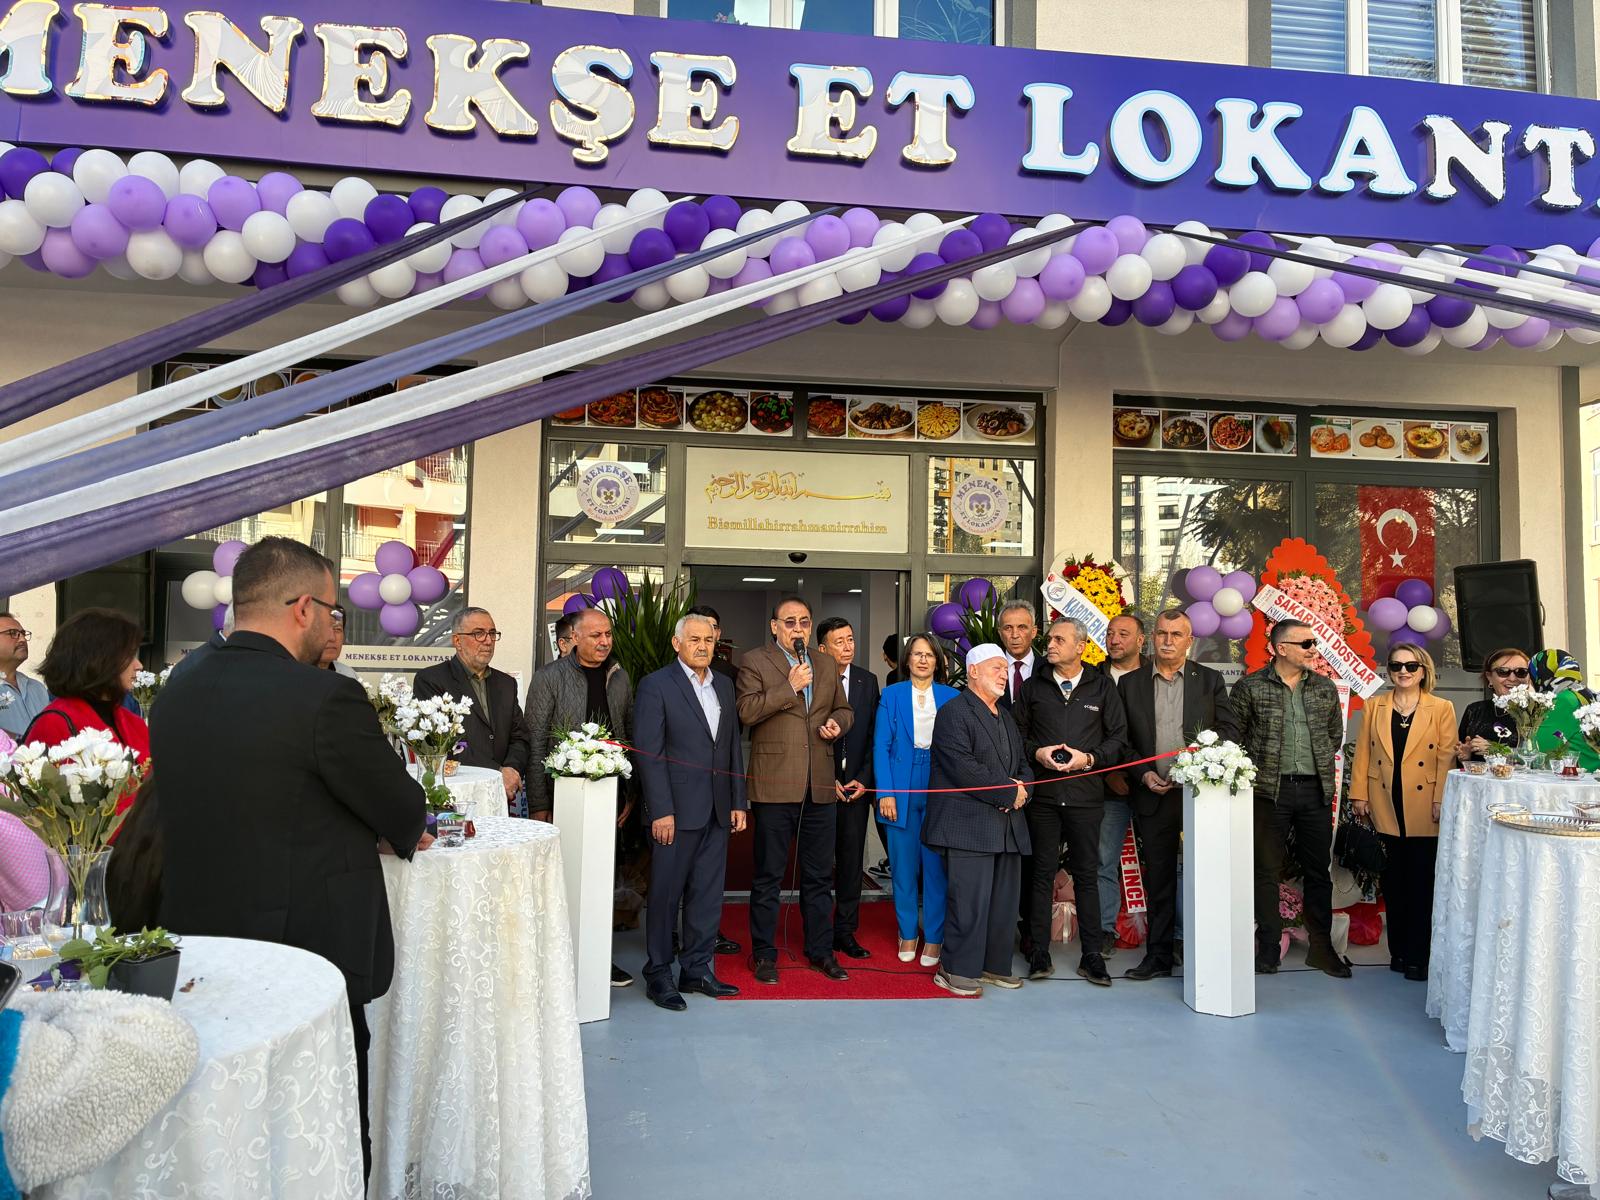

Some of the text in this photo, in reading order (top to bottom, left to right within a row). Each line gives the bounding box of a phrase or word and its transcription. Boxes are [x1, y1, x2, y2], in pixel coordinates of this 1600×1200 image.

[785, 62, 976, 167] ET
[1021, 82, 1600, 208] LOKANT
[1274, 594, 1376, 685] SAKARYALI DOSTLAR
[1123, 868, 1145, 909] İNCE
